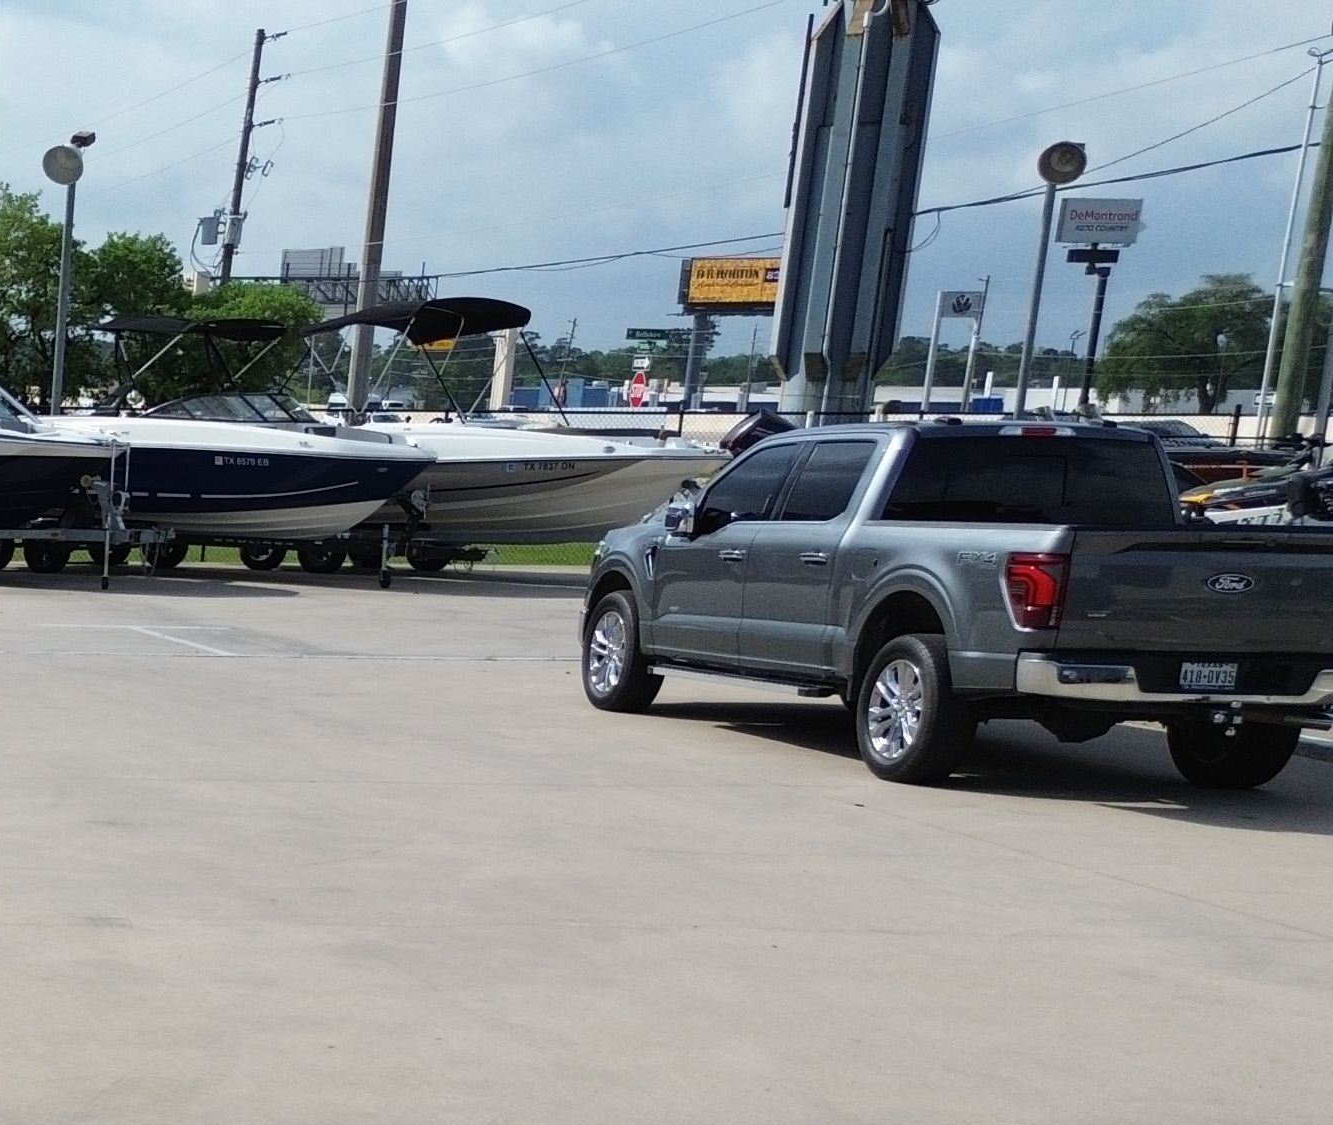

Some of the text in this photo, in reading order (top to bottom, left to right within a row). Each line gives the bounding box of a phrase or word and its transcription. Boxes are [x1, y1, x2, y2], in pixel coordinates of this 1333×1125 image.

[1070, 210, 1139, 221] DeMontrond
[224, 457, 235, 465] TX
[524, 463, 535, 471] TX
[956, 551, 999, 566] FX4
[1215, 576, 1247, 590] Ford
